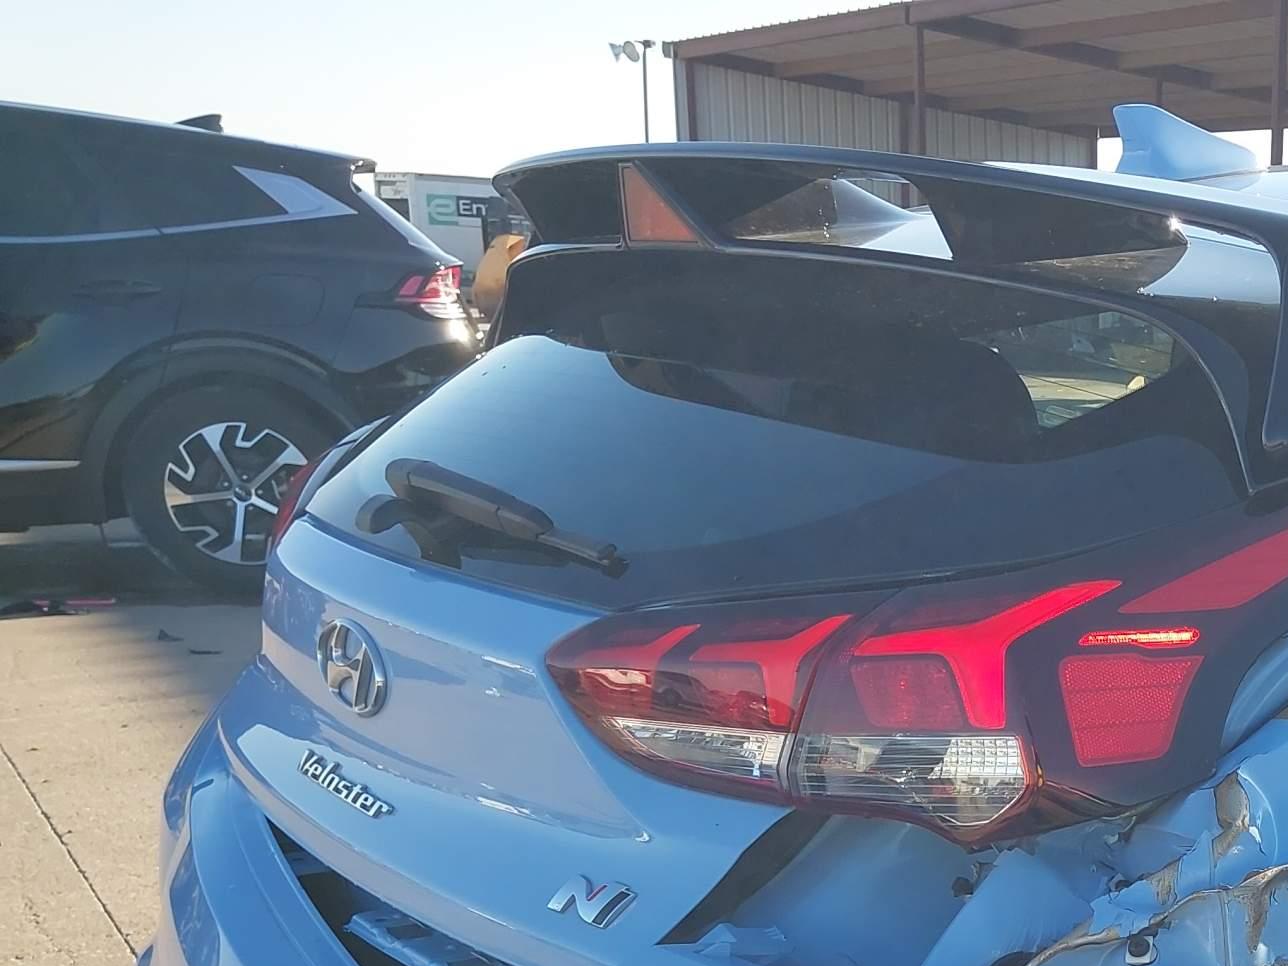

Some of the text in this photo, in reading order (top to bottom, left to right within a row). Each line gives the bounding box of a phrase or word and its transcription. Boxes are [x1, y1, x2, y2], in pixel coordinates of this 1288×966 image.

[459, 199, 488, 216] En
[298, 749, 396, 818] Veloster
[547, 874, 638, 929] N
